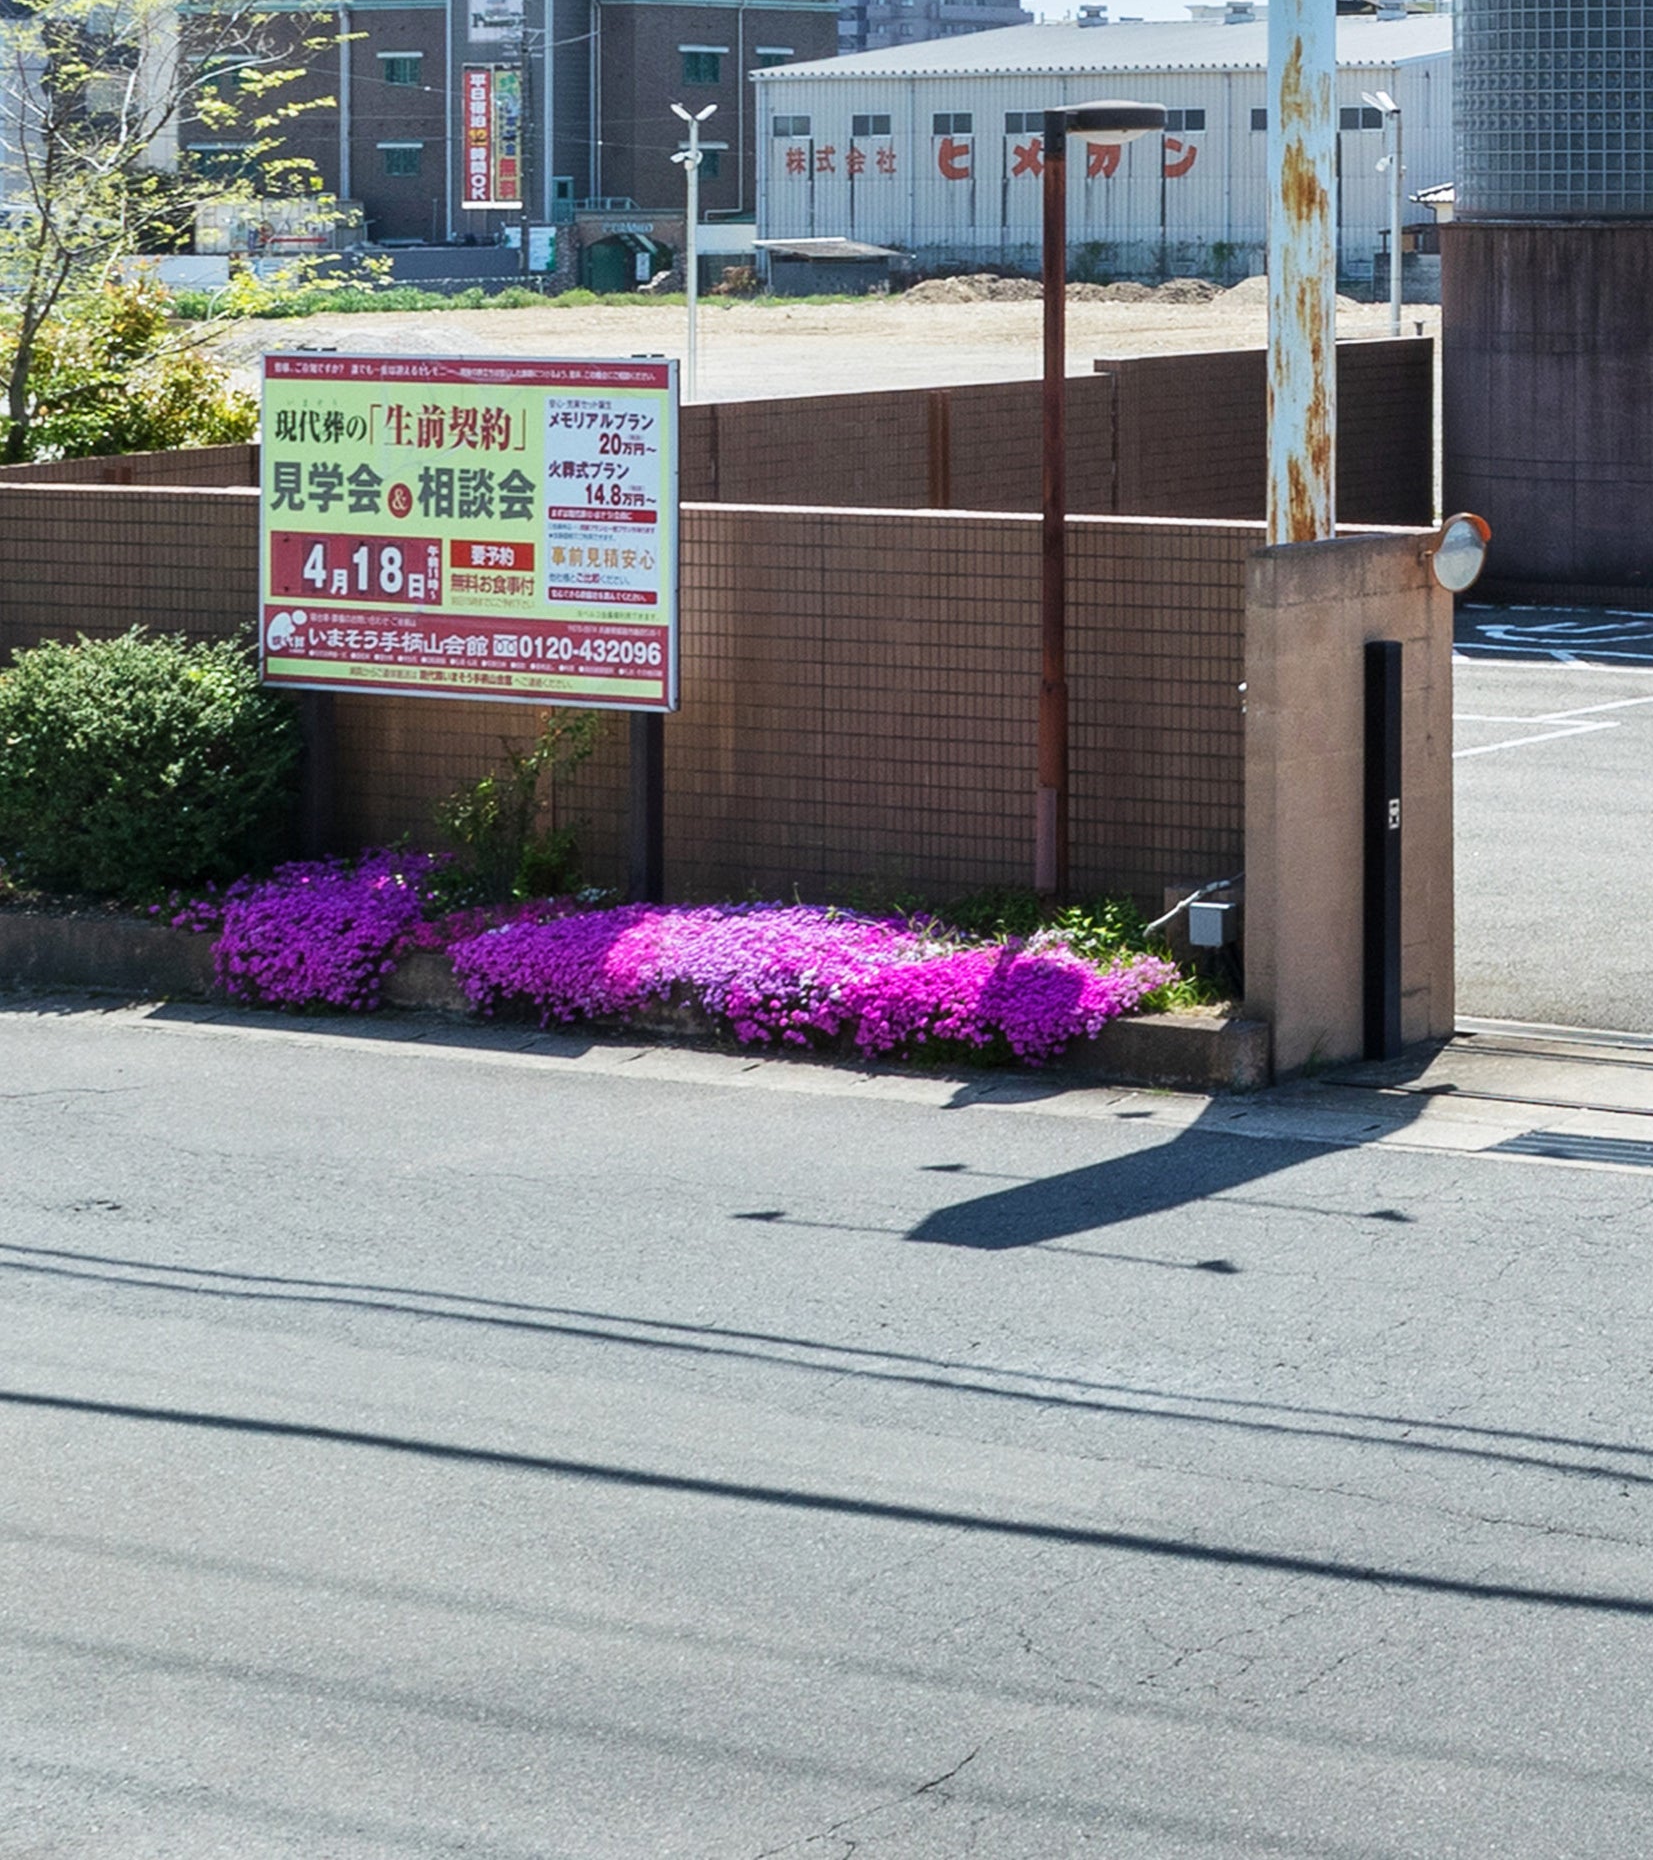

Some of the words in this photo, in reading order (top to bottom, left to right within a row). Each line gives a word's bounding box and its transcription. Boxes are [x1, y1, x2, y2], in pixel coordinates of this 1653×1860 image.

[785, 145, 897, 175] 株式会社
[471, 545, 515, 567] 要予約
[451, 573, 535, 597] 無料お食事付
[308, 627, 489, 659] いまそう手柄山会館
[518, 635, 662, 666] 0120-432096
